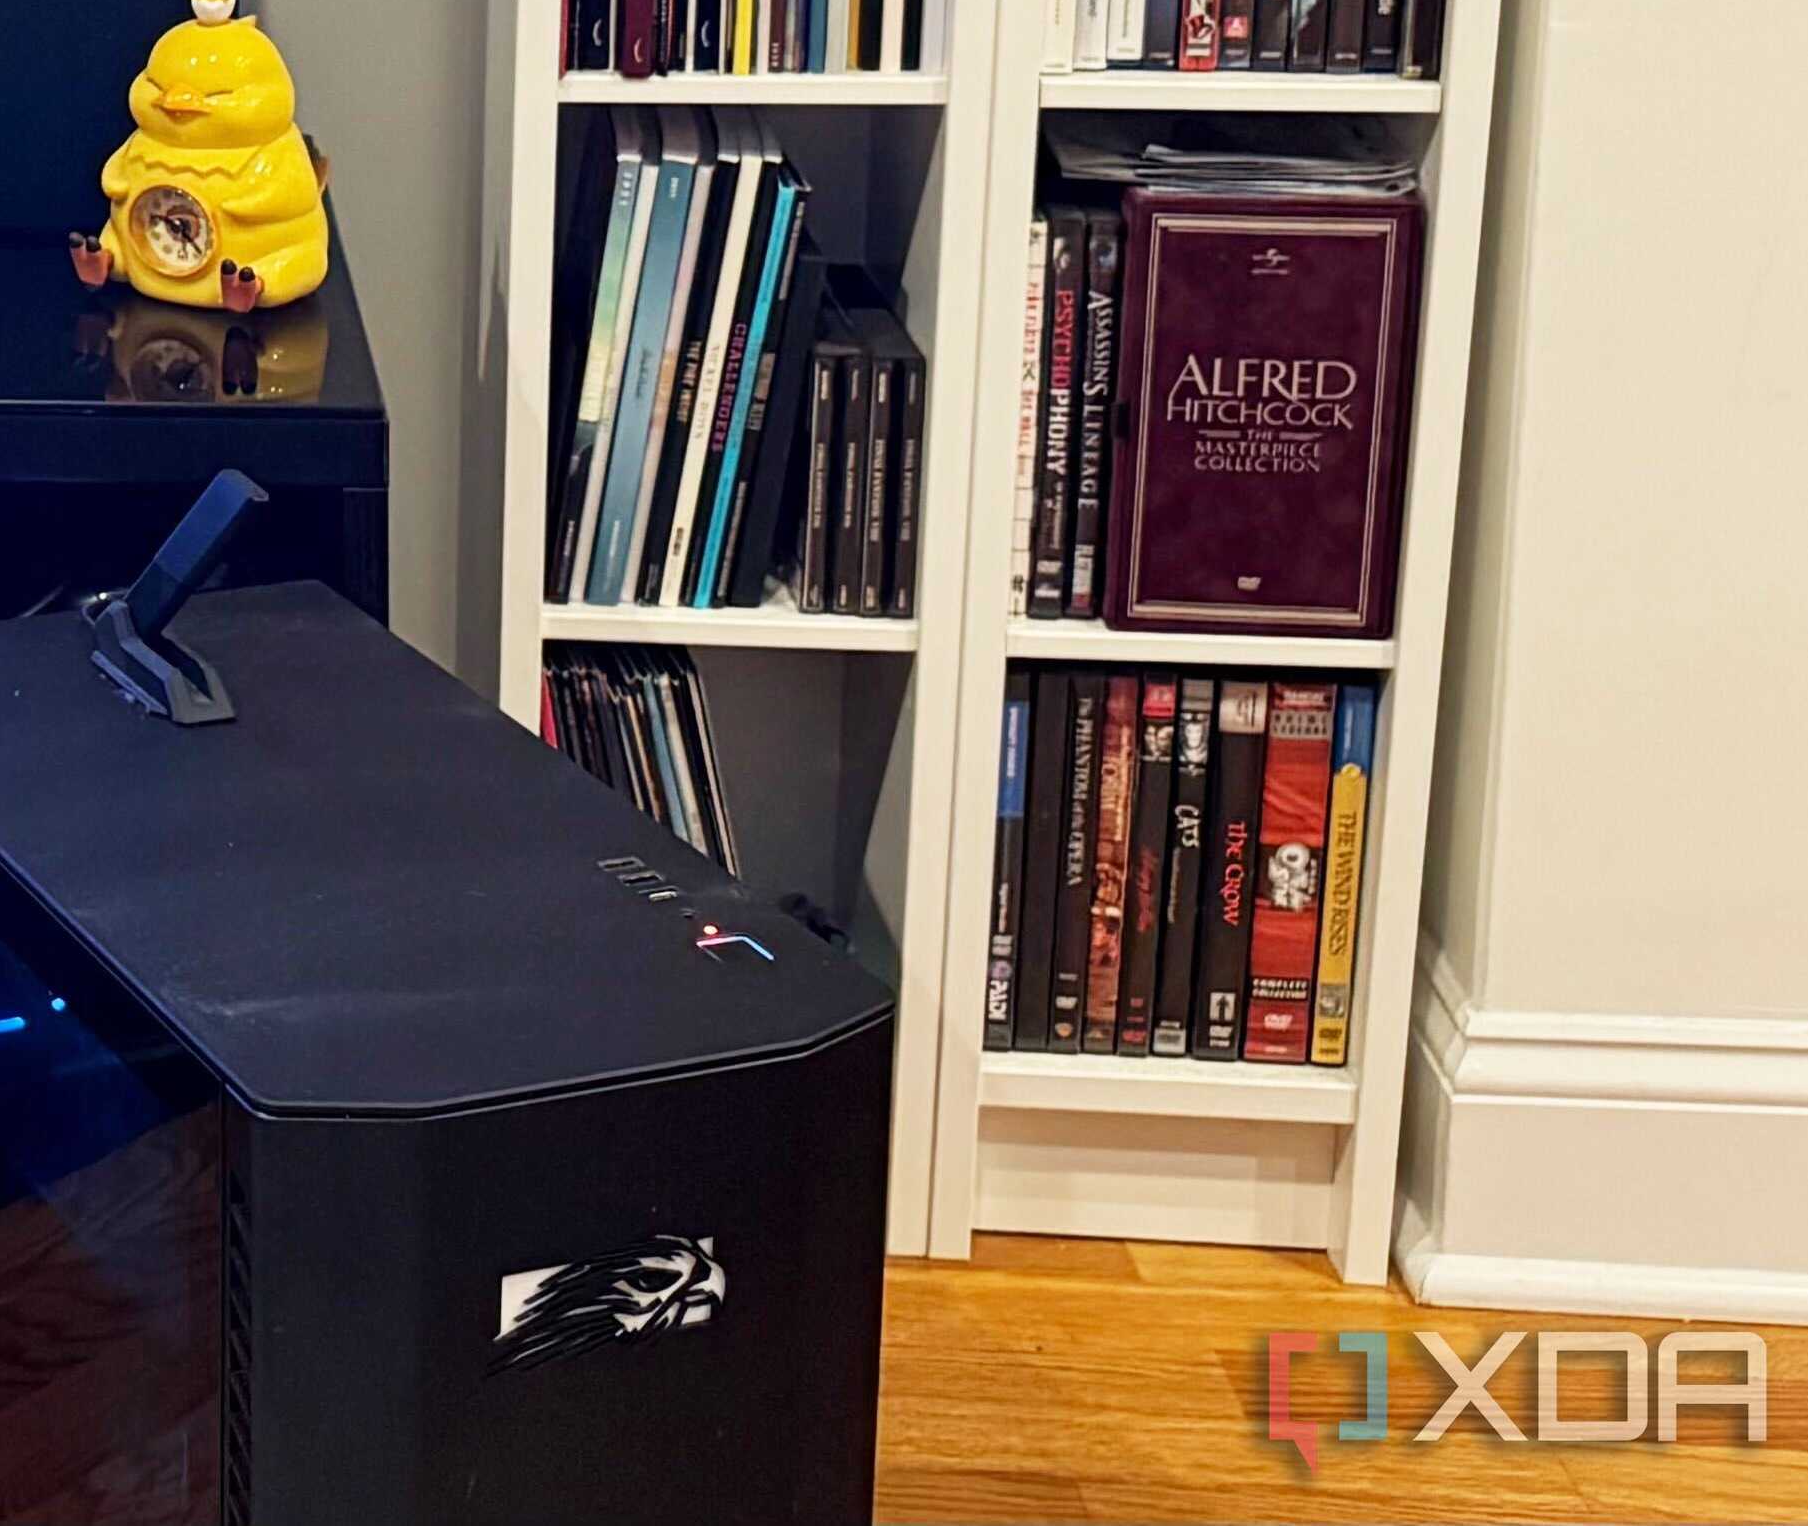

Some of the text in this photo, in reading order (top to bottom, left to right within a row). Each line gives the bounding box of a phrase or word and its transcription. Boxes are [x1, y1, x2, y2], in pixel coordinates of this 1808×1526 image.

[1048, 289, 1075, 475] PSYCHOPHONY
[1168, 353, 1357, 401] ALFRED
[1168, 399, 1354, 430] HITCHCOCK
[1195, 441, 1321, 458] MASTERPIECE
[1247, 429, 1273, 441] THE
[1195, 457, 1321, 473] COLLECTION
[1174, 805, 1200, 849] CATS
[1327, 812, 1356, 957] THE WIND RISES
[988, 980, 1008, 1019] PADI
